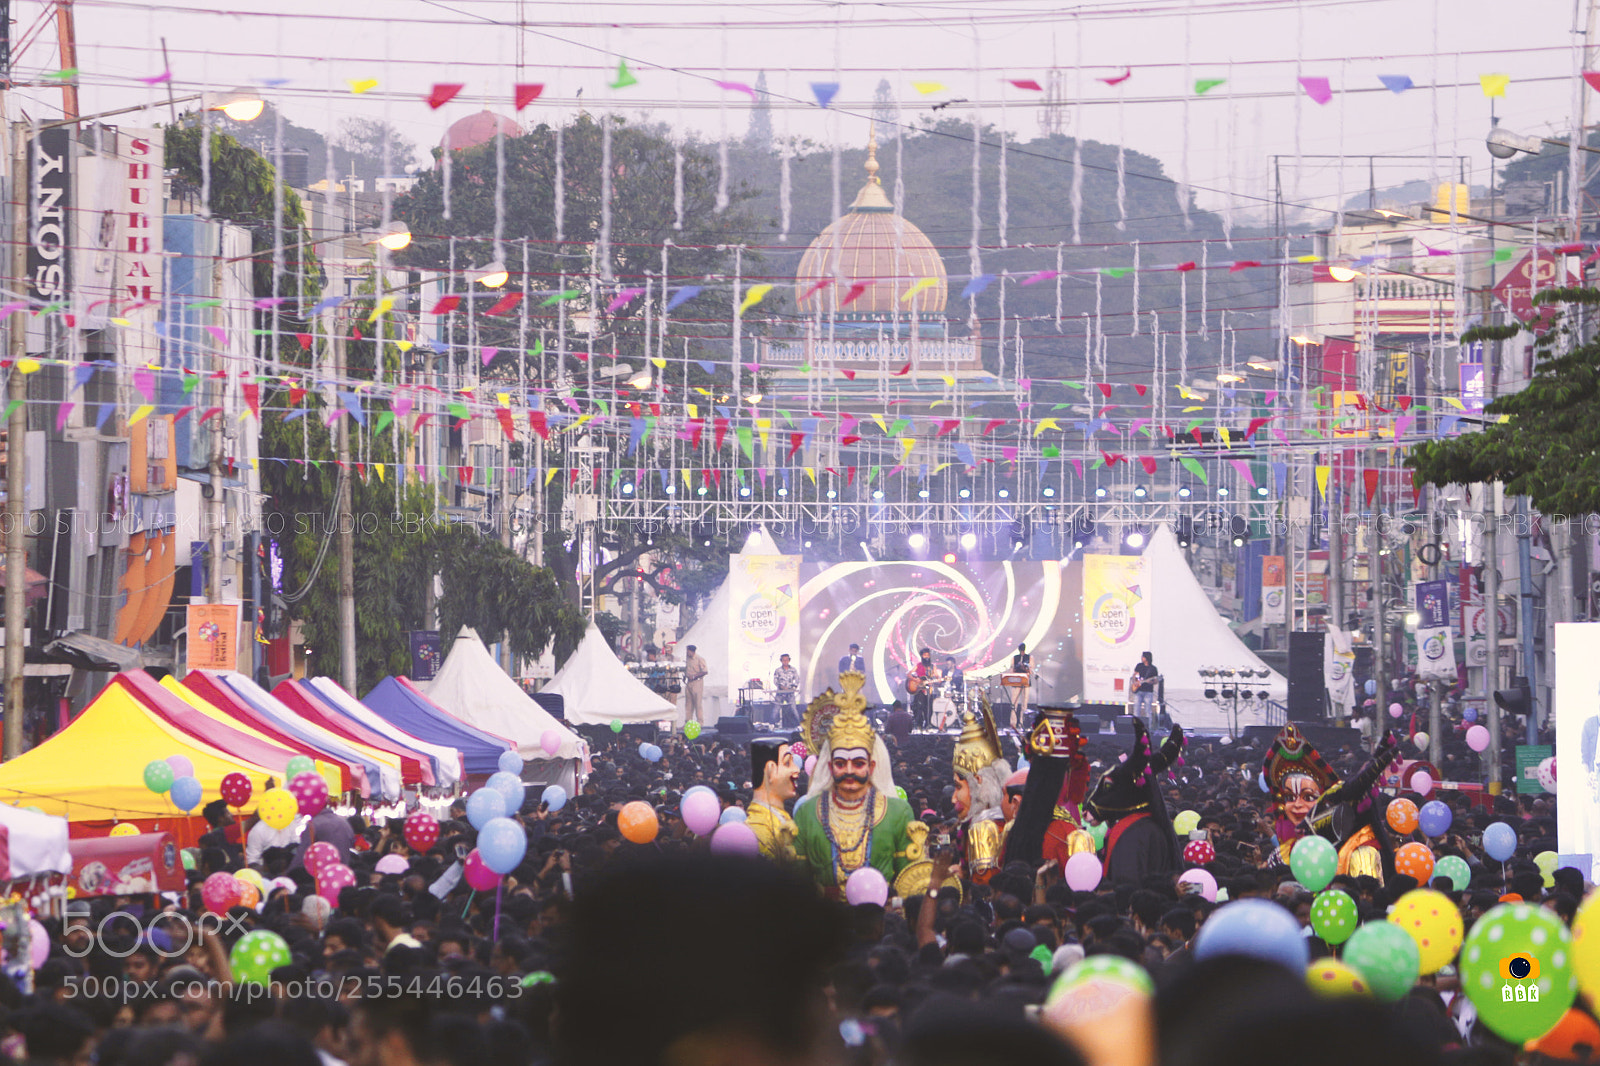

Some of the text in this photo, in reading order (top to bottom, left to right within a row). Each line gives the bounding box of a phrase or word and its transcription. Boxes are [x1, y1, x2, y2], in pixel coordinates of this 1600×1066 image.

[36, 145, 65, 297] SONY
[750, 610, 773, 621] open
[1101, 610, 1124, 621] open
[741, 618, 774, 629] street
[1093, 618, 1125, 629] street
